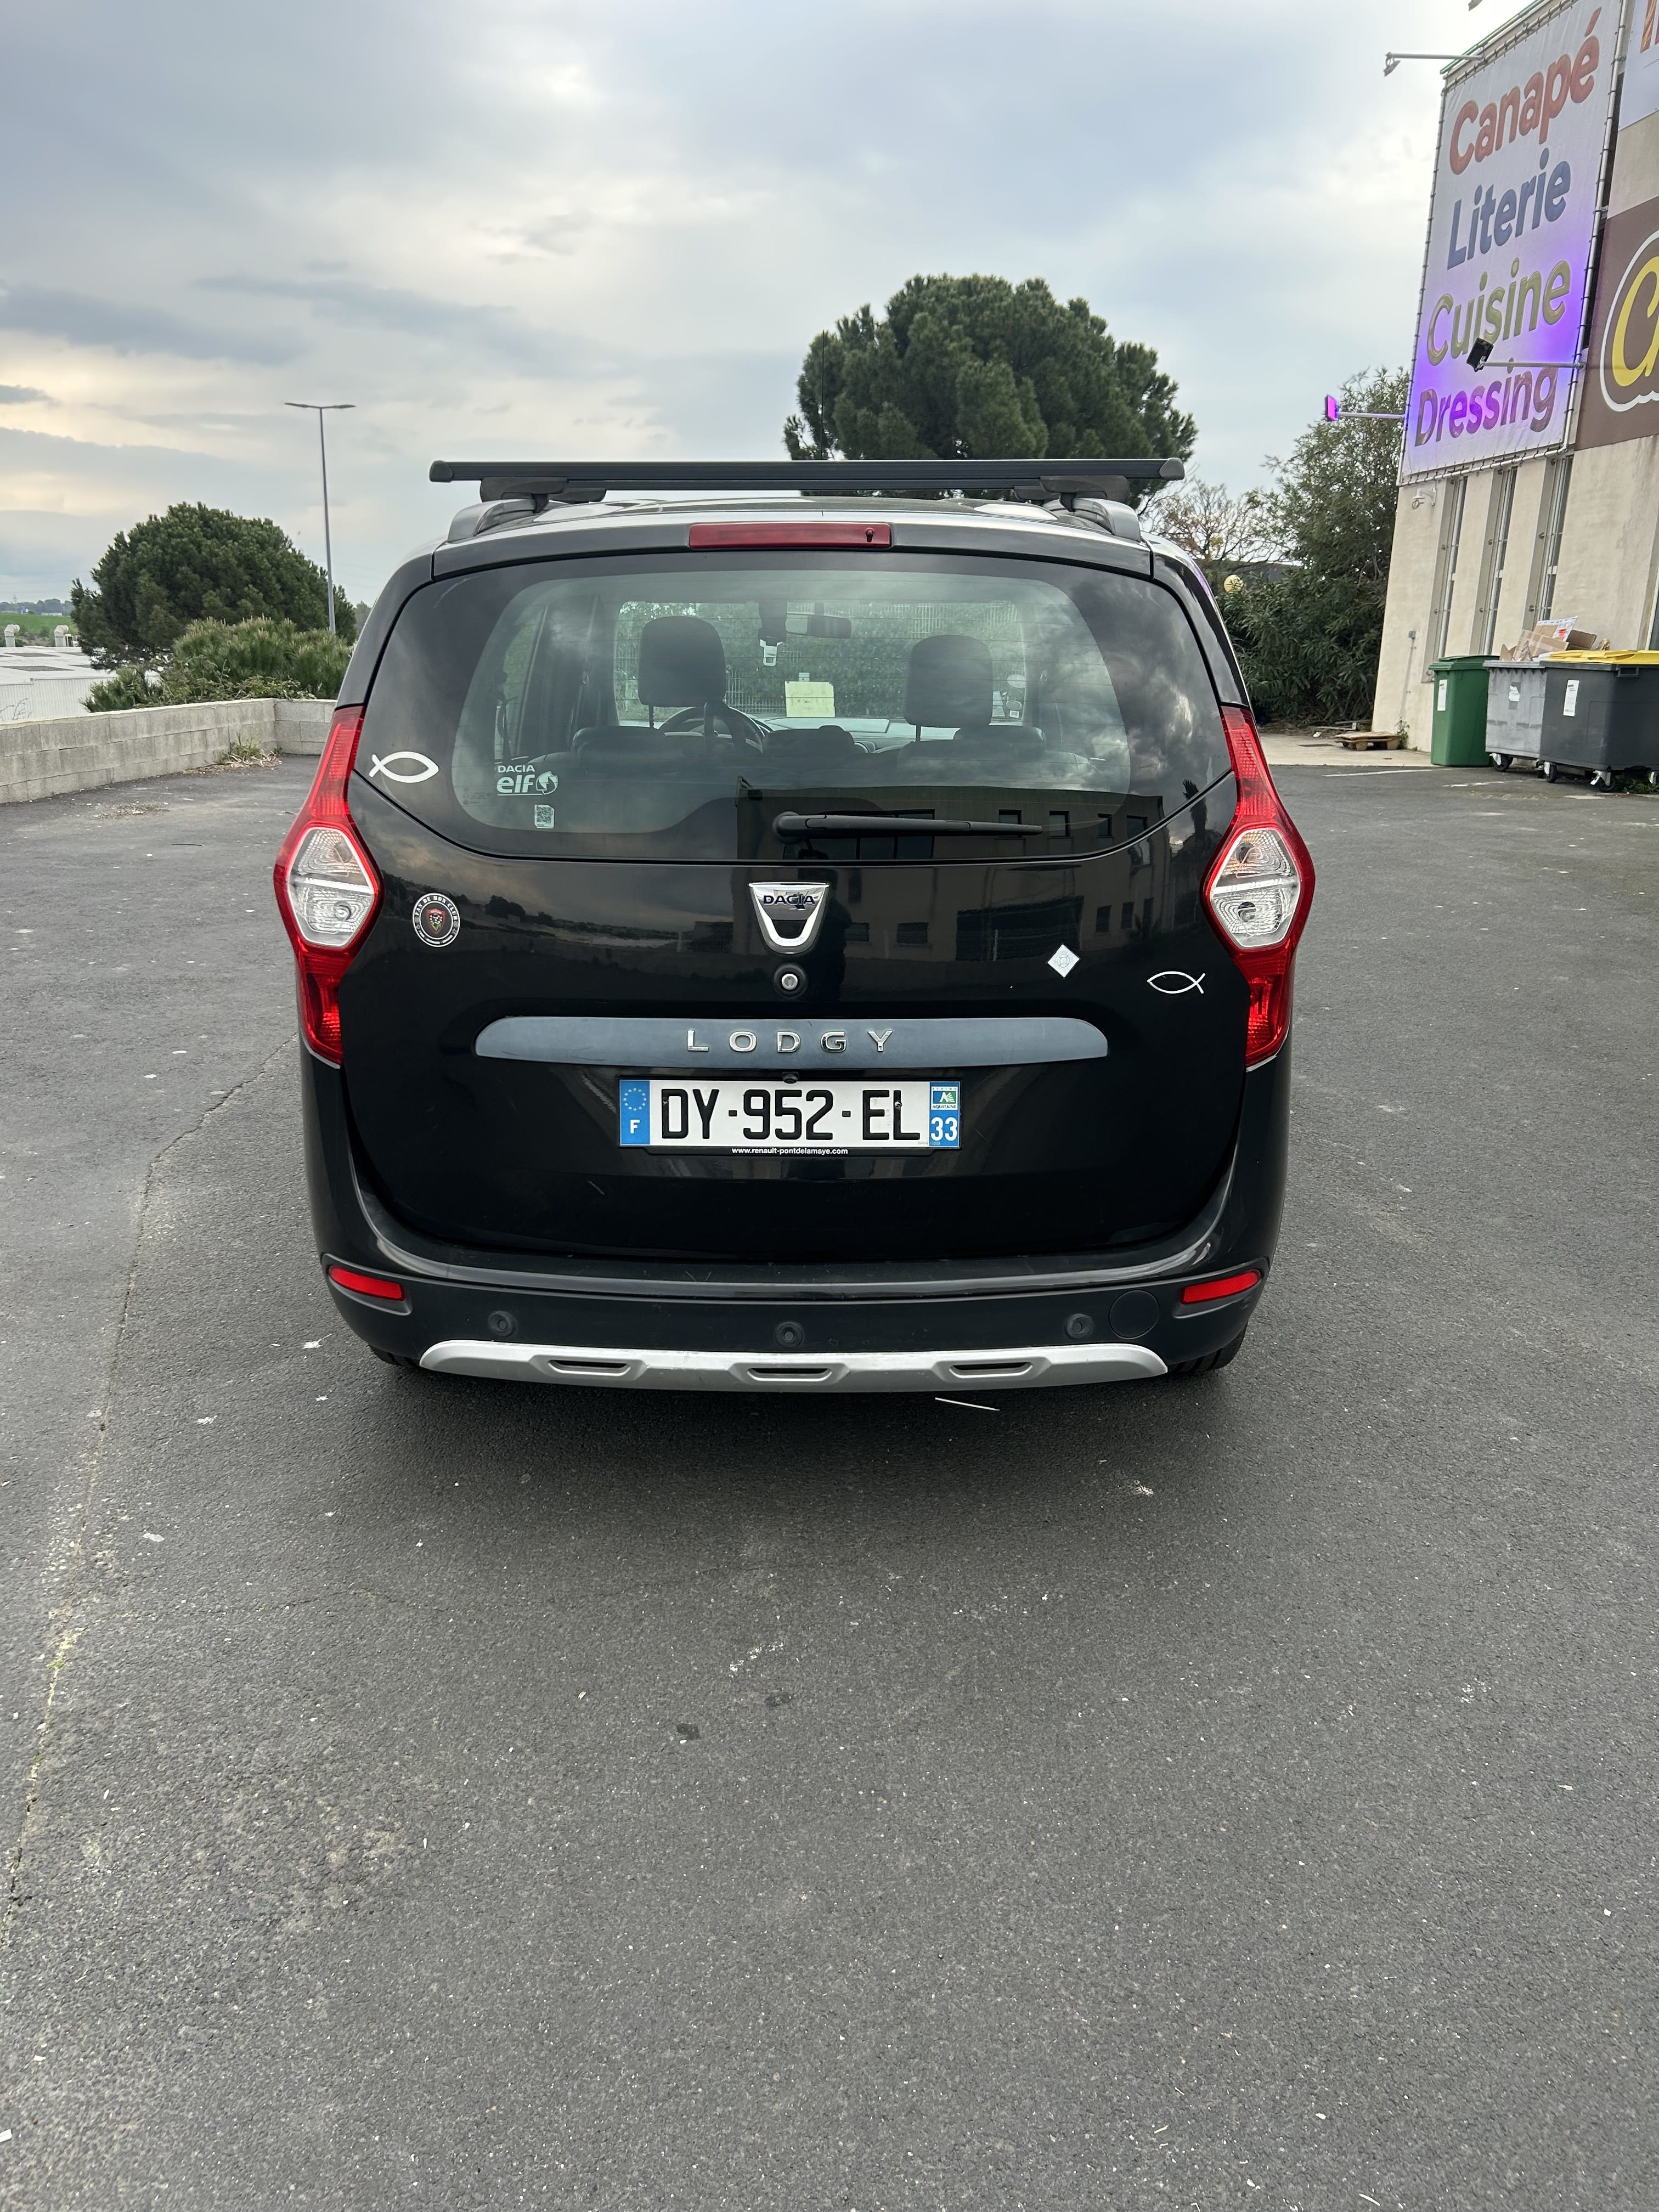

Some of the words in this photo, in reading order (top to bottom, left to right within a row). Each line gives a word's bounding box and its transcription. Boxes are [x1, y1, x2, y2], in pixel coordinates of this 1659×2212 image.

[1449, 7, 1601, 175] Canapé
[1447, 147, 1571, 270] Literie
[1427, 257, 1571, 366] Cuisine
[1414, 357, 1559, 447] Dressing
[498, 765, 535, 773] DACIA
[496, 774, 535, 793] elf
[763, 895, 815, 905] DACIA
[687, 1029, 894, 1052] LODGY
[661, 1088, 921, 1141] DY-952-EL
[629, 1119, 640, 1134] F
[930, 1117, 957, 1141] 33
[731, 1147, 848, 1155] www.renault-pontdelamaye.com
